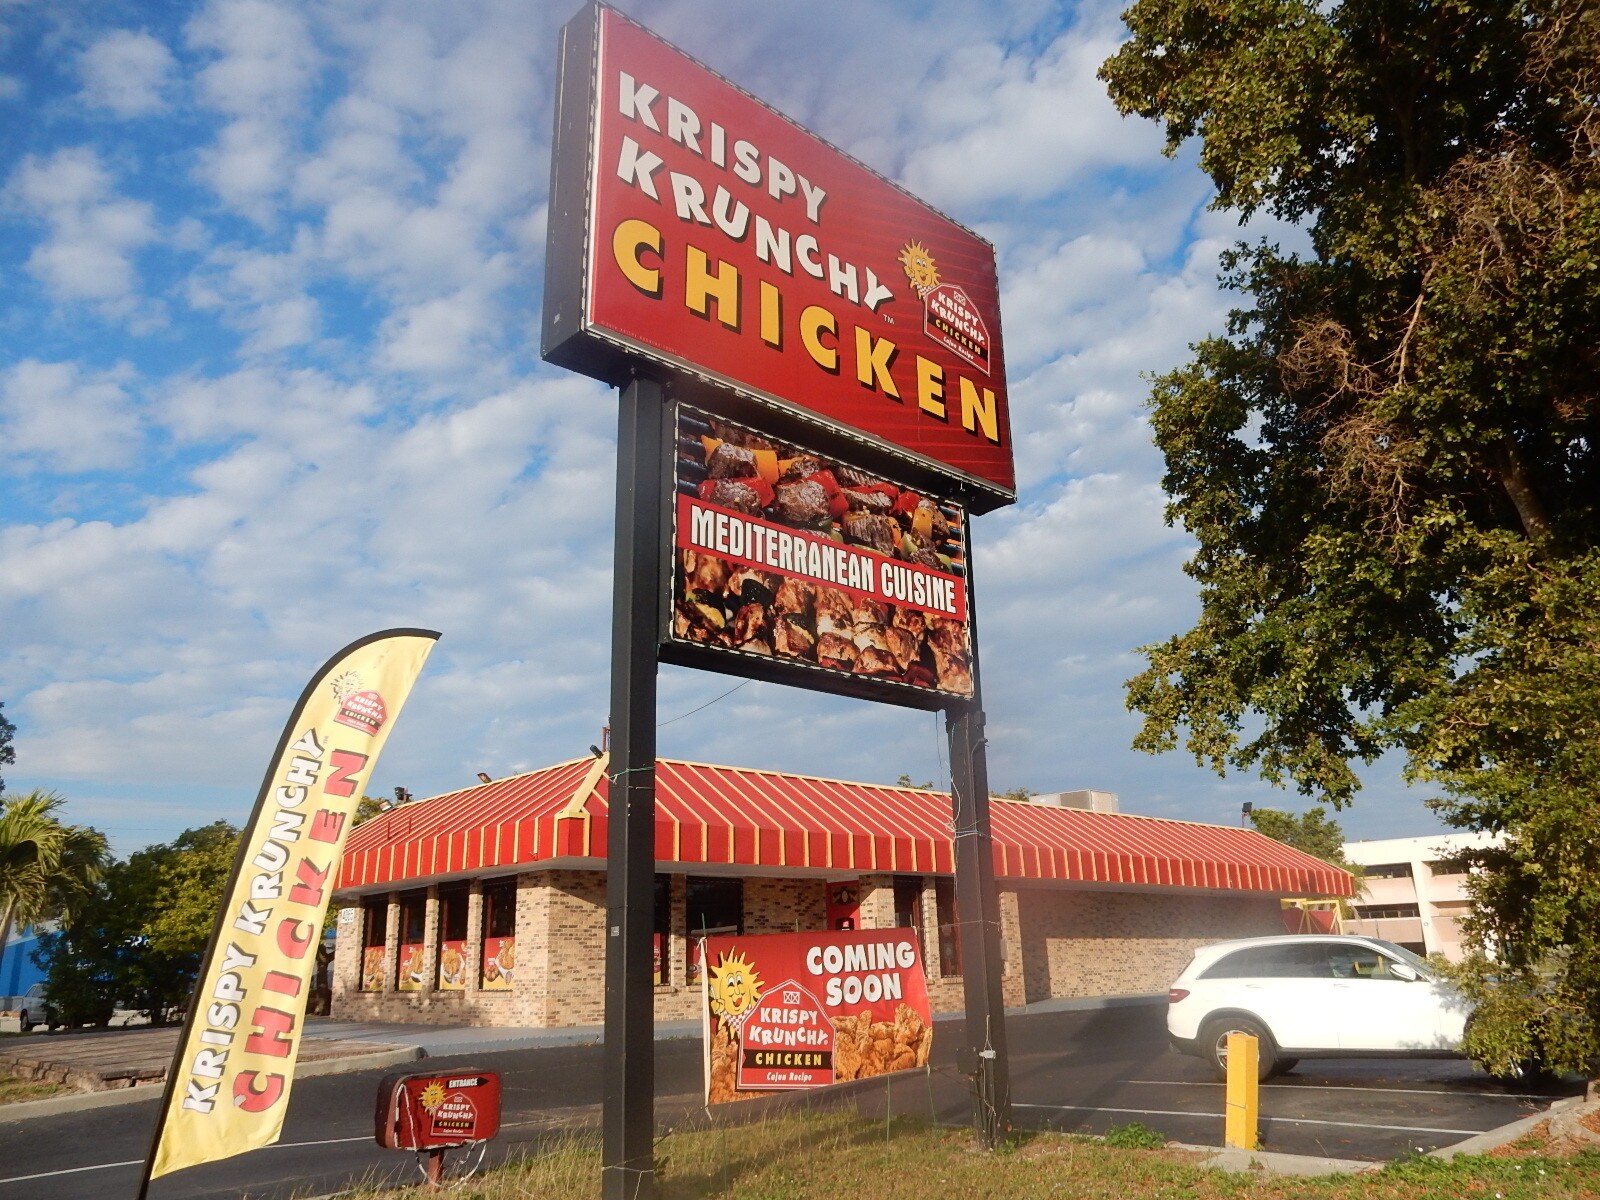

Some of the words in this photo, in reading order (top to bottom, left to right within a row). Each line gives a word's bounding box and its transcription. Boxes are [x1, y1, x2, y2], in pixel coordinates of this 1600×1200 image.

[619, 70, 827, 224] KRISPY
[616, 136, 894, 313] KRUNCHY
[931, 298, 985, 343] KRUNCHY
[938, 291, 979, 327] KRISPY
[612, 218, 1000, 443] CHICKEN
[935, 318, 981, 355] CHICKEN
[690, 504, 875, 593] MEDITERRANEAN
[880, 562, 957, 614] CUISINE
[345, 710, 376, 725] CHICKEN
[355, 696, 383, 711] KRISPY
[182, 942, 258, 1115] KRISPY
[234, 728, 326, 937] KRUNCHY
[233, 748, 369, 1113] CHICKEN
[806, 941, 916, 975] COMING
[825, 972, 903, 1006] SOON
[760, 1007, 818, 1025] KRISPY
[749, 1025, 828, 1046] KRUNCHY
[755, 1053, 822, 1066] CHICKEN
[766, 1071, 787, 1082] Cajun
[789, 1072, 812, 1082] Recipe
[449, 1078, 477, 1088] ENTRANCE
